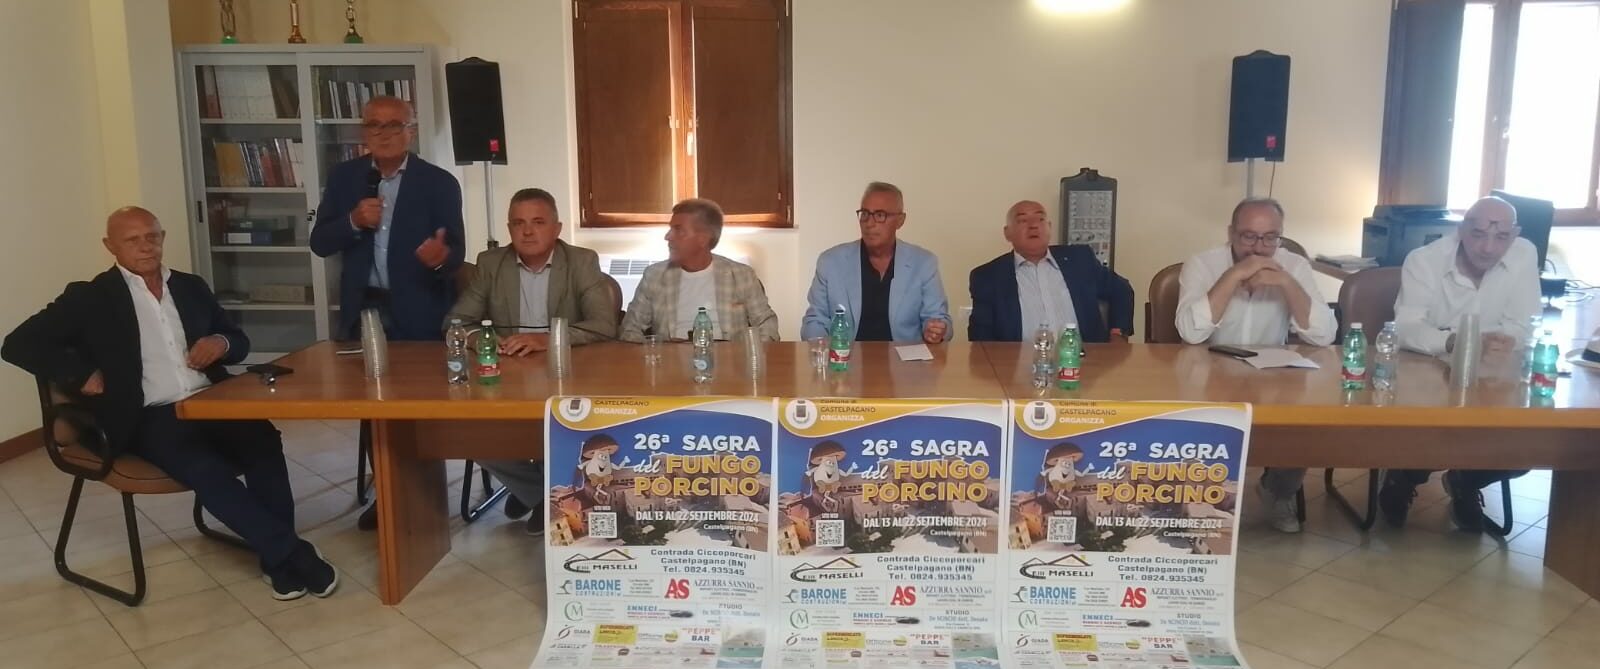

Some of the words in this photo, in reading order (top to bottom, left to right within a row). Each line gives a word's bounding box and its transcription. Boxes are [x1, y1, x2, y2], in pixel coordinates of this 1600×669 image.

[1059, 408, 1117, 416] CASTELPAGANO
[682, 434, 761, 452] SAGRA
[910, 439, 989, 457] SAGRA
[1149, 442, 1229, 459] SAGRA
[633, 459, 661, 473] del
[666, 455, 761, 474] FUNGO
[861, 465, 888, 480] del
[894, 460, 990, 480] FUNGO
[1097, 465, 1126, 480] del
[1131, 462, 1228, 483] FUNGO
[633, 476, 760, 496] PORCINO
[862, 482, 988, 502] PORCINO
[1096, 484, 1226, 504] PORCINO
[636, 511, 653, 521] DAL
[655, 511, 664, 520] 13
[665, 511, 676, 520] AL
[676, 511, 689, 520] 22
[689, 511, 738, 521] SETTEMBRE
[739, 512, 759, 522] 2024
[863, 517, 880, 528] DAL
[882, 517, 891, 527] 13
[892, 517, 903, 527] AL
[903, 516, 915, 526] 22
[916, 516, 964, 527] SETTEMBRE
[964, 516, 987, 527] 2024
[1096, 517, 1113, 526] DAL
[1115, 517, 1124, 526] 13
[1125, 517, 1136, 527] AL
[1137, 518, 1149, 527] 22
[1150, 518, 1199, 528] SETTEMBRE
[1200, 518, 1222, 529] 2024
[697, 549, 756, 561] Ciccoporcari
[877, 556, 921, 564] Contrada
[923, 555, 985, 565] Ciccoporcari
[1108, 556, 1152, 564] Contrada
[1155, 556, 1218, 566] Ciccoporcari
[660, 557, 726, 567] Castelpagano
[728, 559, 747, 569] (BN)
[887, 564, 953, 573] Castelpagano
[955, 564, 976, 573] (BN)
[663, 565, 681, 573] Tel.
[684, 566, 745, 576] 0824.935345
[1118, 565, 1184, 574] Castelpagano
[1187, 566, 1207, 575] (BN)
[910, 573, 973, 581] 0824.935345
[1141, 574, 1205, 583] 0824.935345
[575, 579, 621, 591] BARONE
[664, 578, 690, 600] AS
[695, 579, 727, 588] AZZURRA
[728, 580, 755, 589] SANNIO
[921, 586, 955, 594] AZZURRA
[955, 586, 983, 594] SANNIO
[801, 588, 847, 599] BARONE
[890, 585, 916, 606] AS
[1030, 586, 1077, 599] BARONE
[1120, 586, 1147, 608] AS
[1151, 588, 1185, 596] AZZURRA
[1186, 588, 1215, 597] SANNIO
